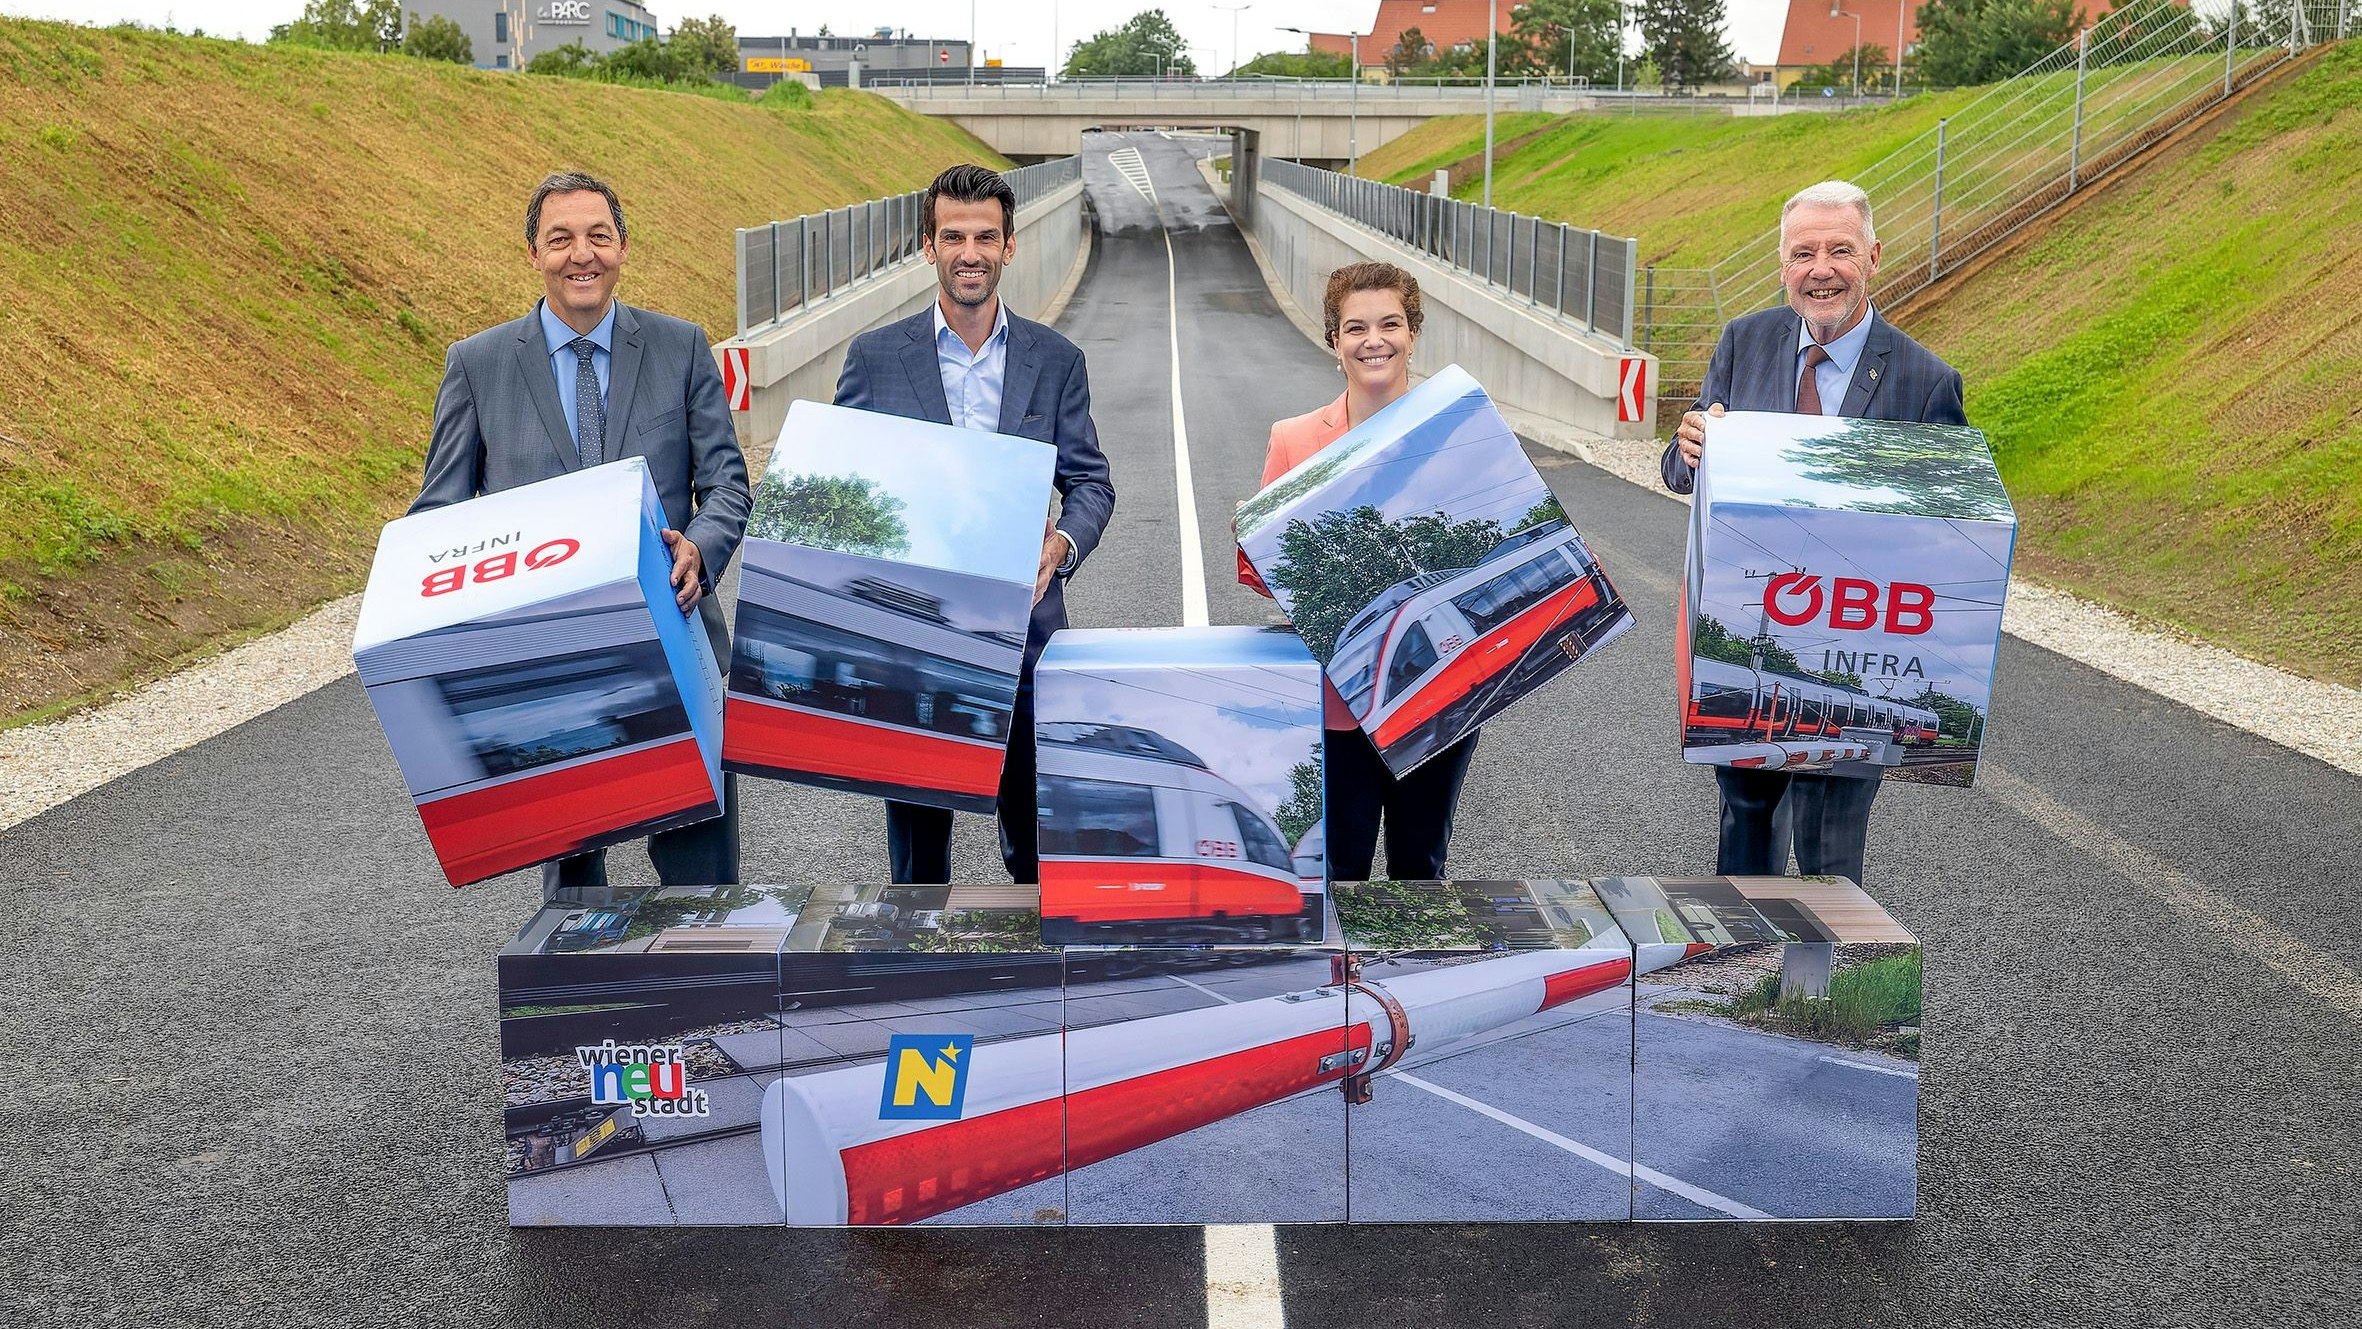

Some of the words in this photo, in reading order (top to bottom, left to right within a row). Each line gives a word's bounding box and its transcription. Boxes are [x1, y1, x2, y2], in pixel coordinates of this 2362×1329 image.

[551, 1, 592, 20] PARC
[428, 531, 521, 563] INFRA
[421, 538, 581, 598] ÖBB
[1763, 572, 1935, 635] ÖBB
[1823, 649, 1925, 679] INFRA
[579, 1041, 679, 1067] wiener
[593, 1062, 682, 1101] neu
[634, 1090, 707, 1114] stadt
